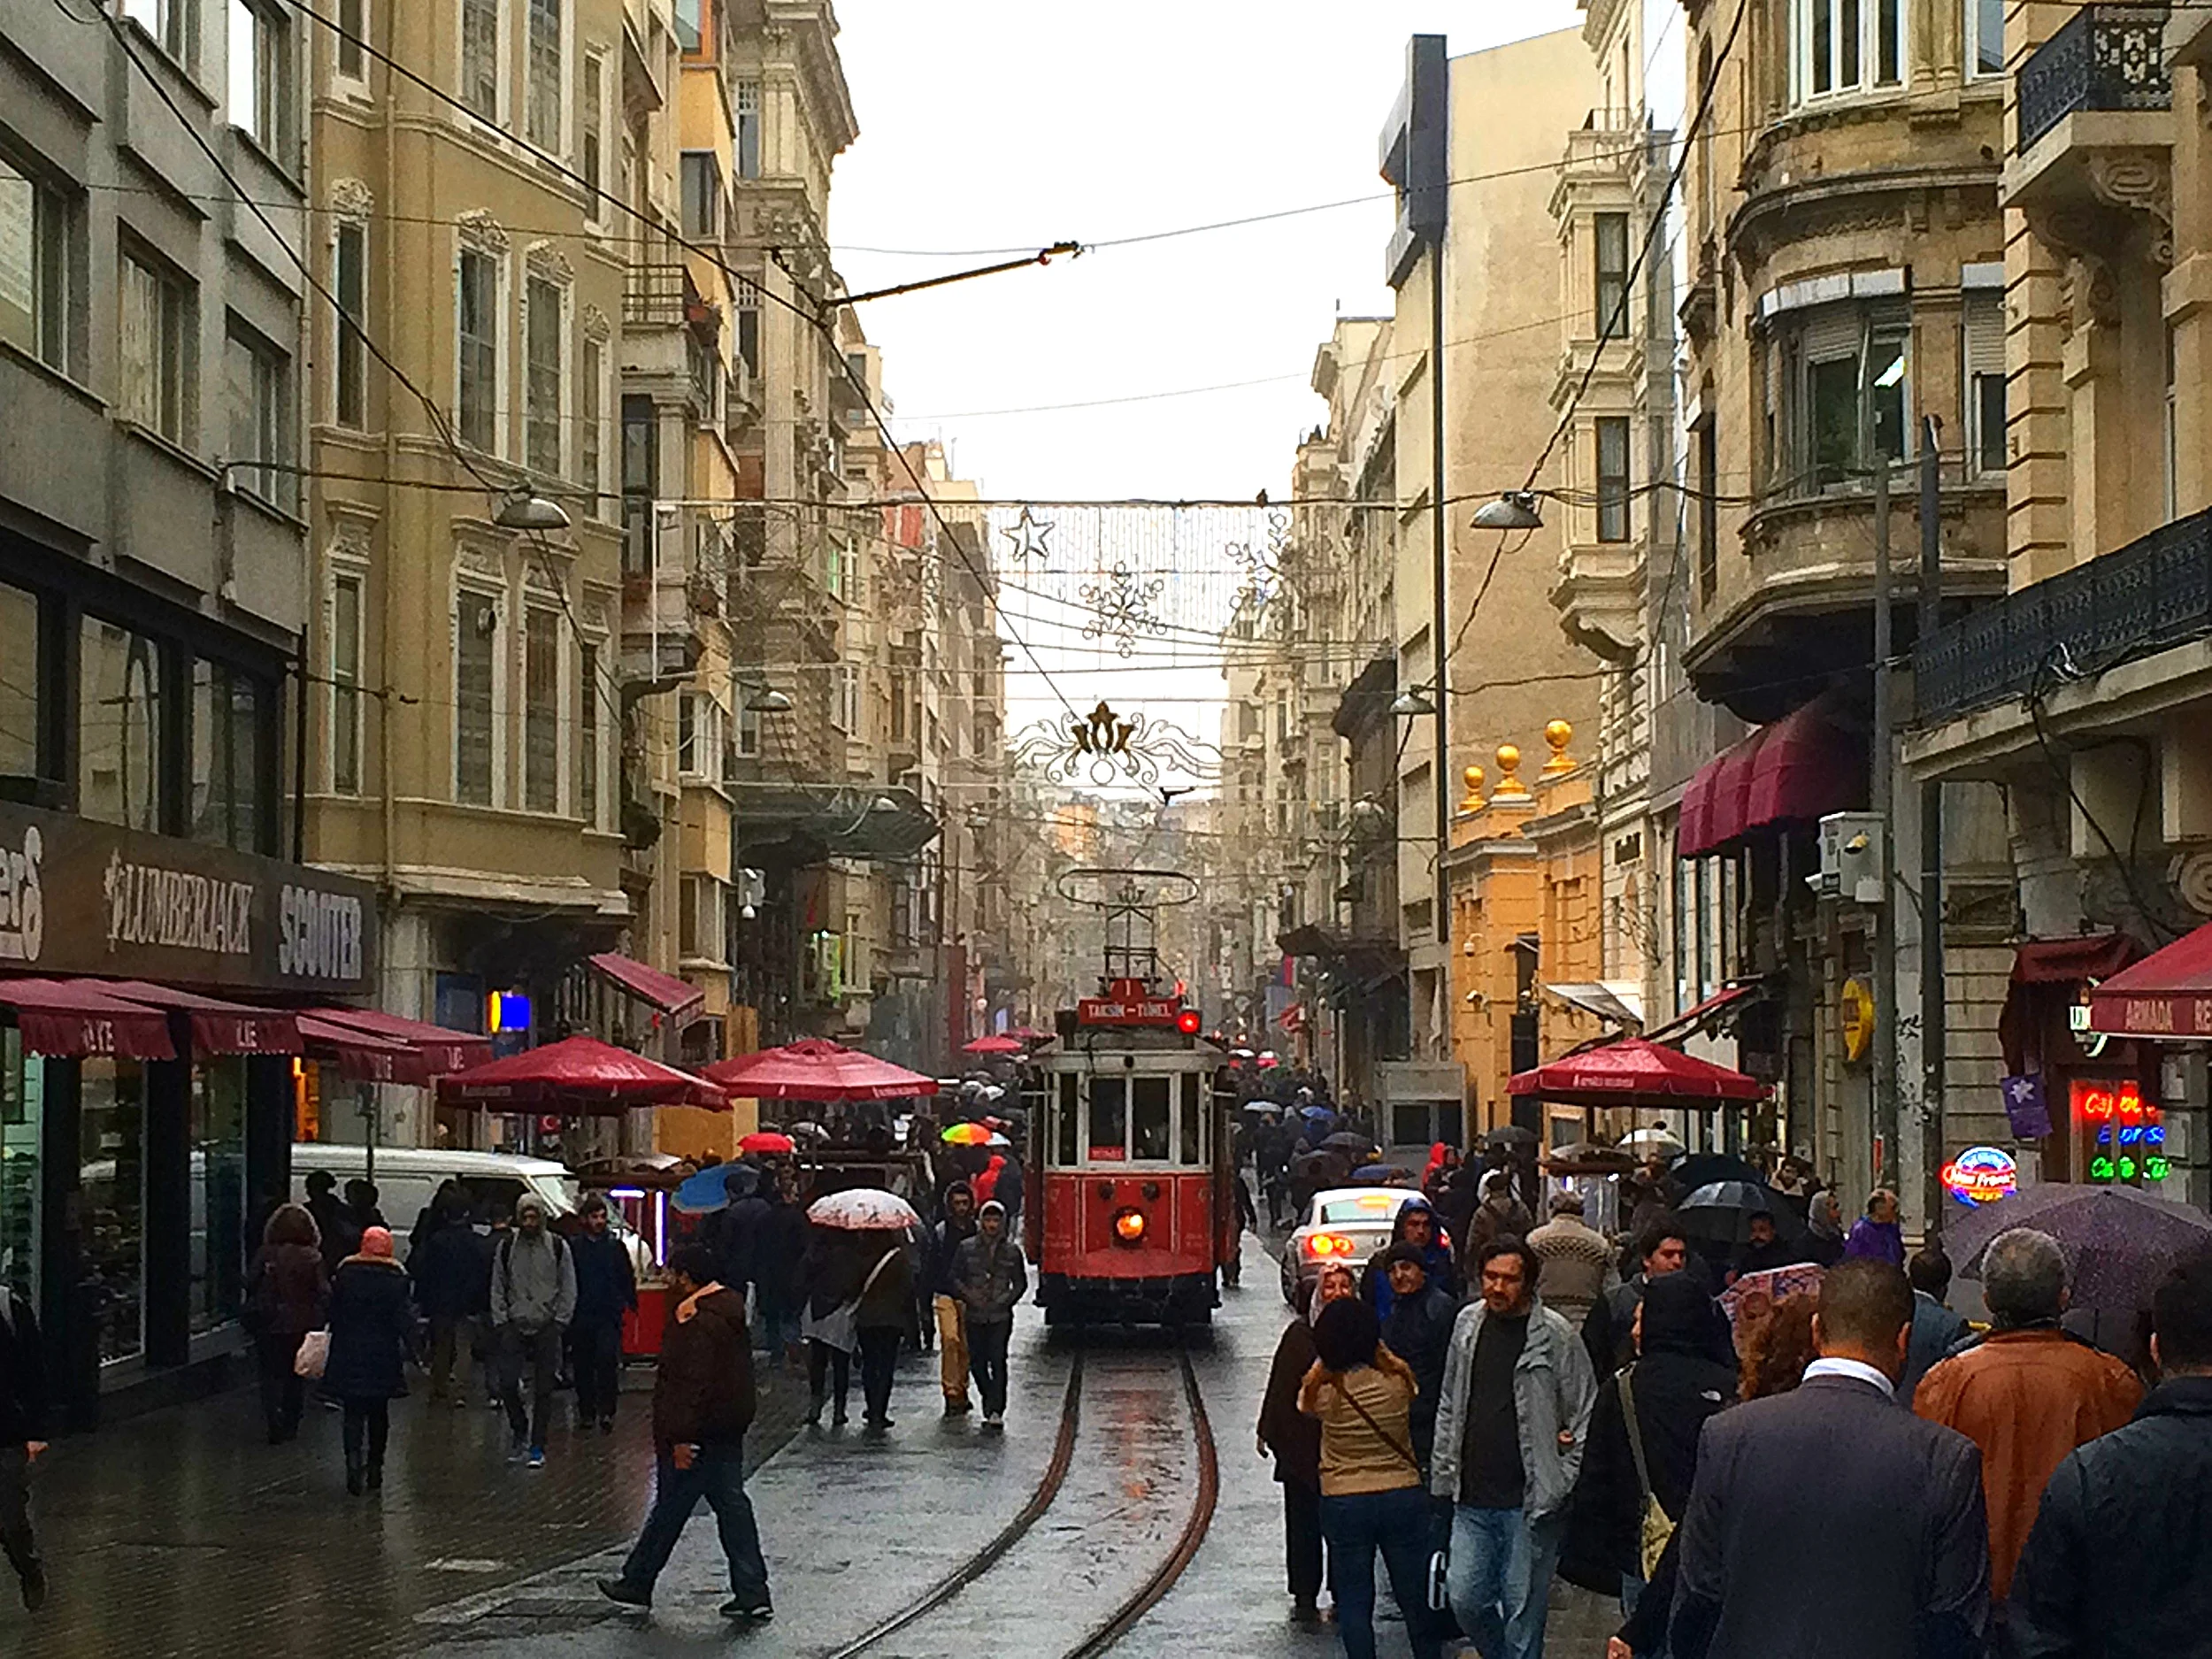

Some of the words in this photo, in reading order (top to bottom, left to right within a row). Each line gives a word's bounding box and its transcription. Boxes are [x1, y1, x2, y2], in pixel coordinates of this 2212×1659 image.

[122, 863, 253, 955] LUMBERJACK
[279, 885, 362, 979] SCOOTER
[2124, 999, 2174, 1031] ARMADA
